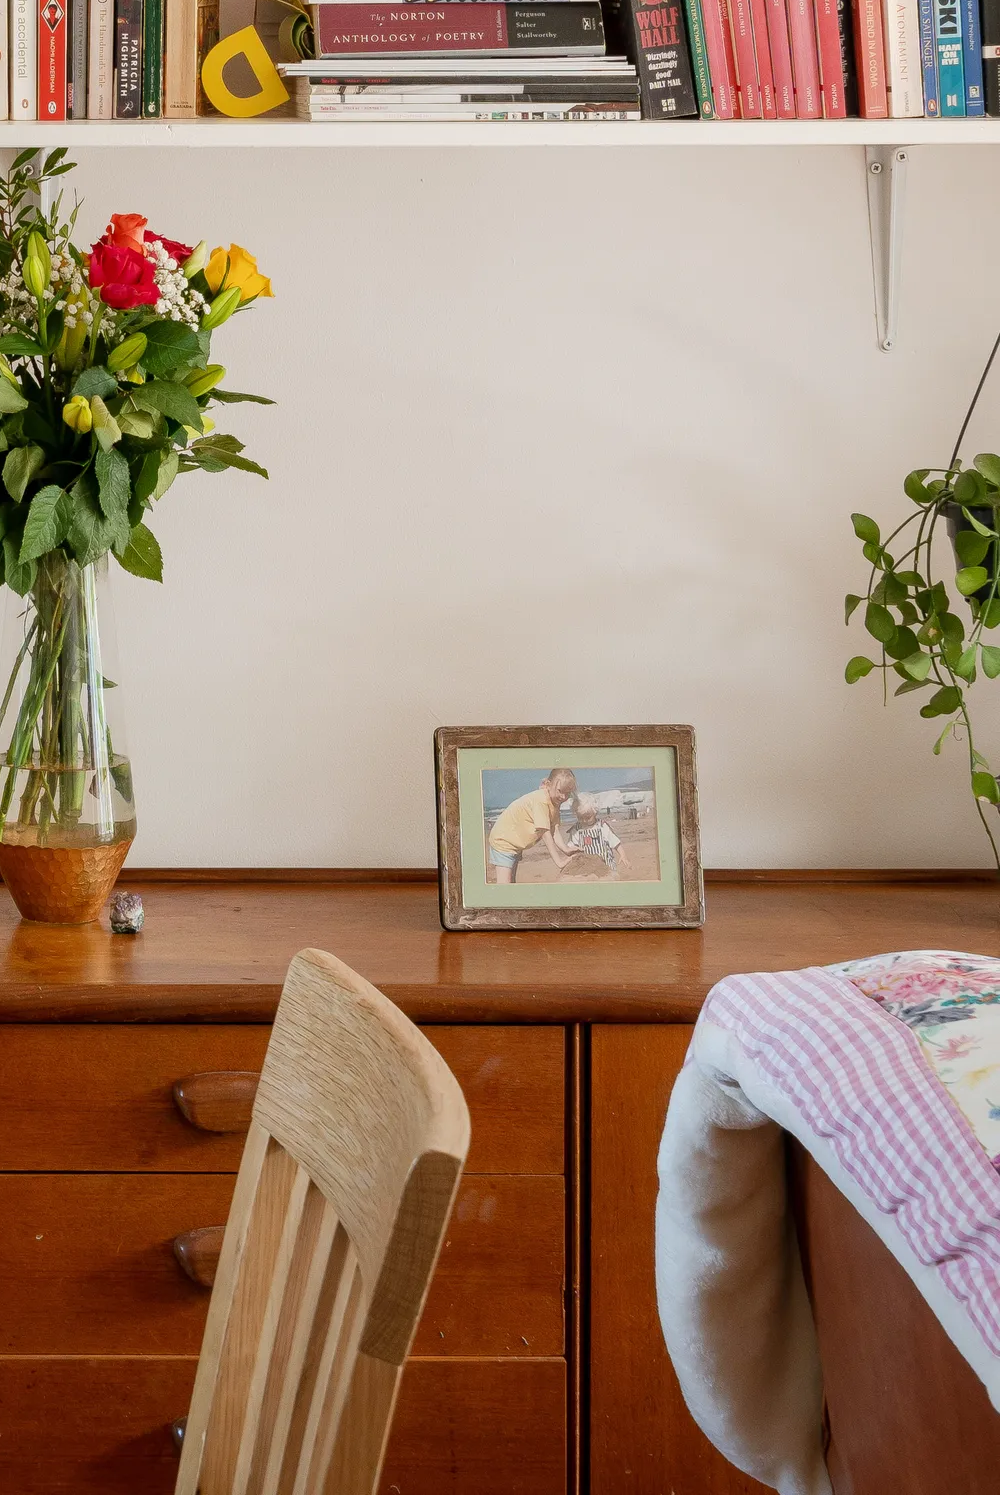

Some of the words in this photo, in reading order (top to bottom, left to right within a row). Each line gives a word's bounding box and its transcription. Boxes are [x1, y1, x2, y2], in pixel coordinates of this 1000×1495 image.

[391, 12, 445, 21] NORTON
[635, 6, 678, 30] WOLF
[17, 17, 28, 78] accidental
[333, 34, 416, 44] ANTHOLOGY
[422, 33, 430, 42] of
[436, 32, 485, 41] POETRY
[638, 27, 679, 49] HALL
[120, 33, 129, 96] HIGHSMITH
[130, 39, 138, 90] PATRICIA
